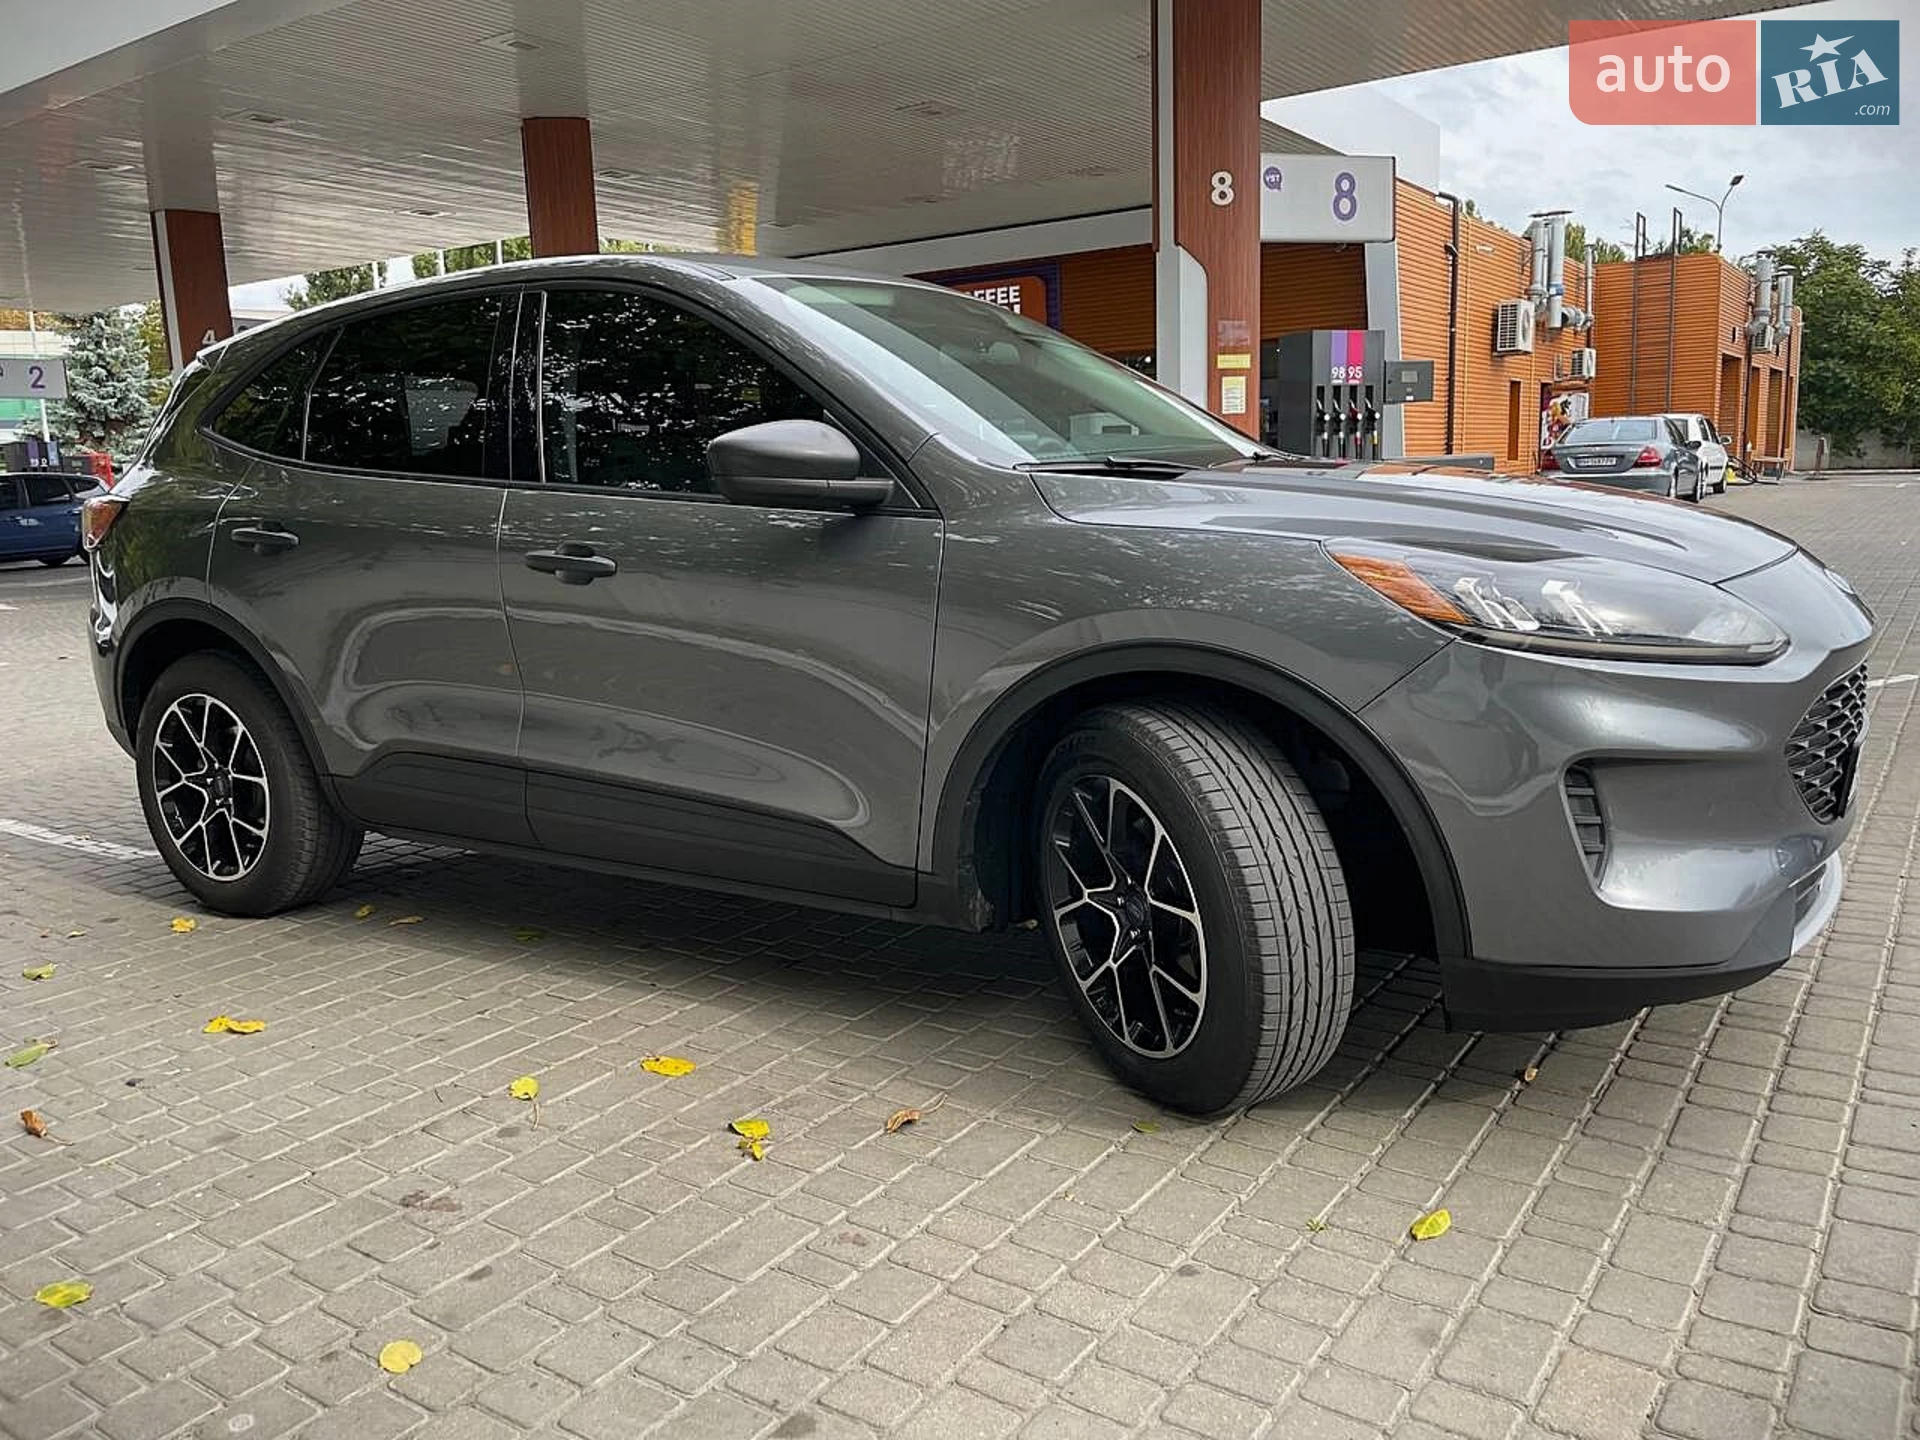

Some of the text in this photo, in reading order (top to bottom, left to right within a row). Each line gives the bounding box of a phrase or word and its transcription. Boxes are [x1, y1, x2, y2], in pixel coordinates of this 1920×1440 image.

[1211, 171, 1235, 206] 8
[1332, 172, 1357, 221] 8
[965, 285, 1021, 304] FFEE
[202, 329, 219, 345] 4
[29, 366, 46, 389] 2
[1331, 366, 1363, 379] 98 95
